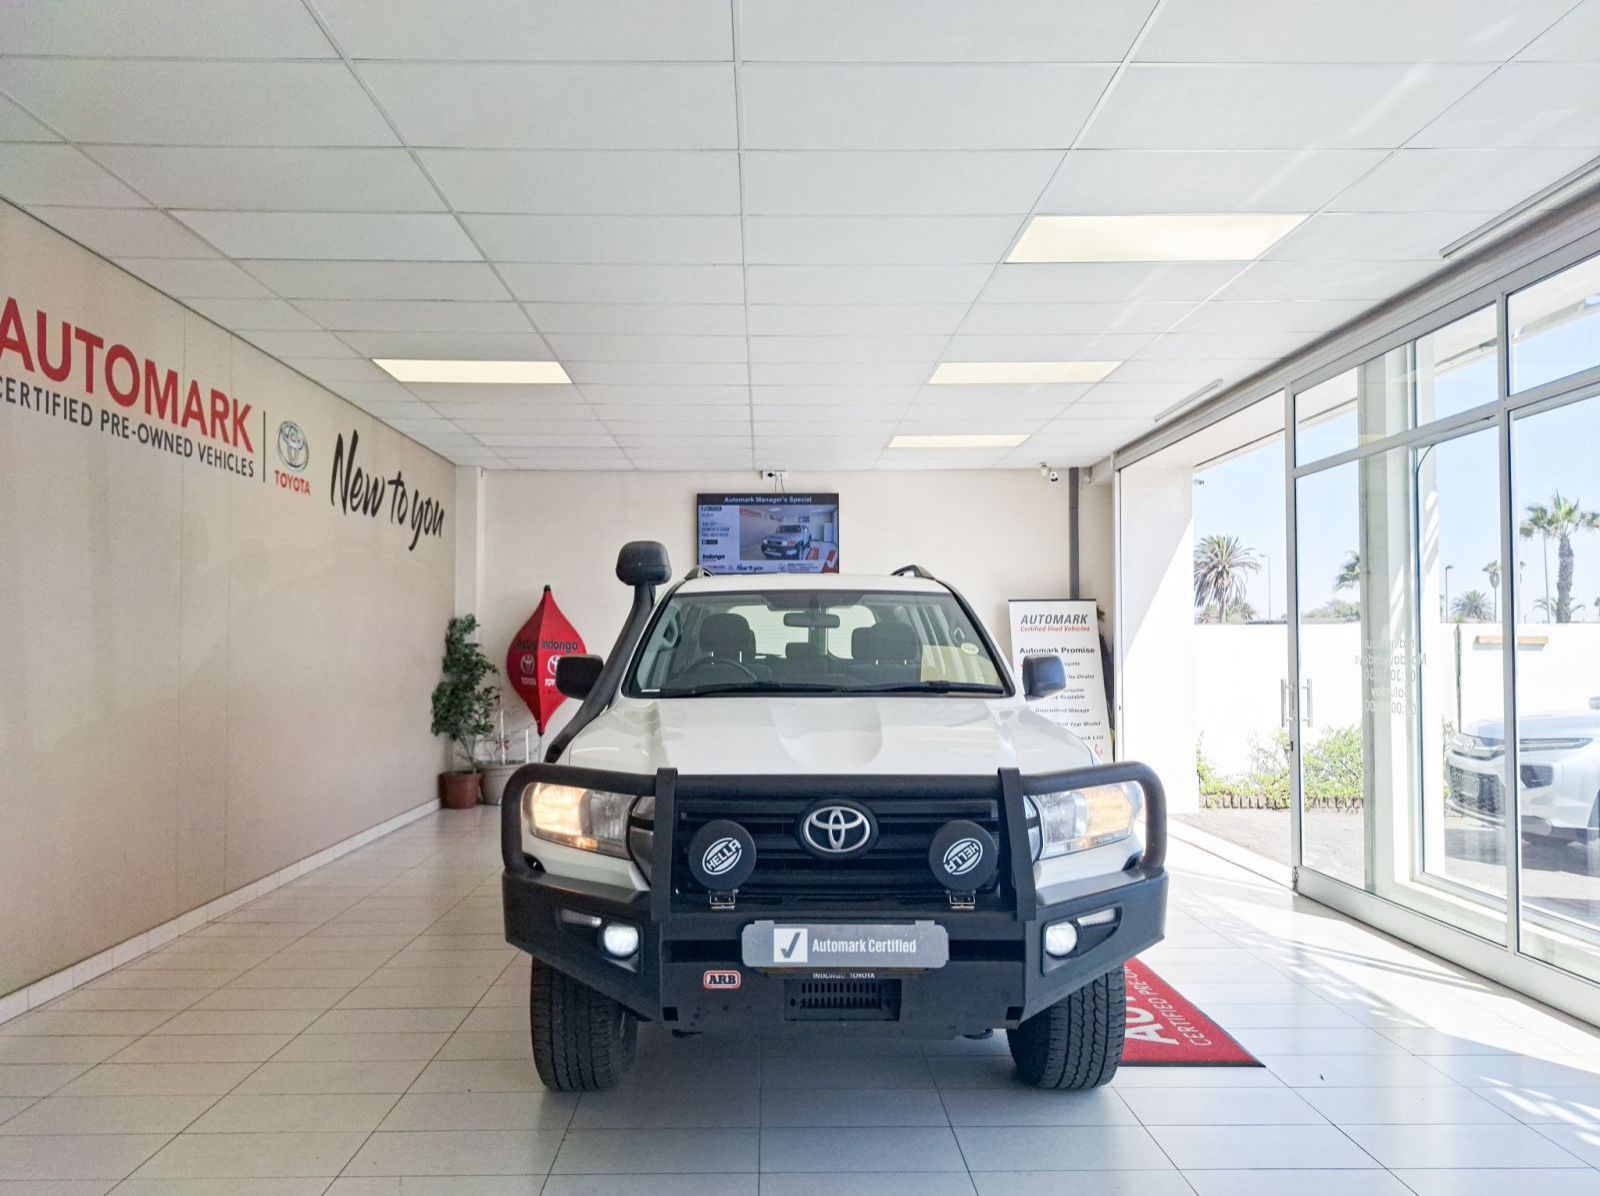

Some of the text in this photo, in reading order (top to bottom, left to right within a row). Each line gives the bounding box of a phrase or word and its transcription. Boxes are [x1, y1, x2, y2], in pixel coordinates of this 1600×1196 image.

[0, 297, 254, 453] AUTOMARK
[100, 409, 194, 458] PRE-OWNED
[198, 442, 255, 478] VEHICLES
[274, 469, 311, 496] TOYOTA
[330, 429, 444, 551] New to you
[755, 496, 788, 504] Manager's
[789, 496, 812, 504] Special
[1020, 614, 1089, 625] AUTOMARK
[541, 639, 578, 653] Indongo
[706, 839, 741, 870] HELLA
[944, 843, 979, 873] HELLA
[812, 939, 917, 953] Automark Certified
[708, 973, 737, 987] ARB
[1147, 997, 1212, 1046] CERTIFIED
